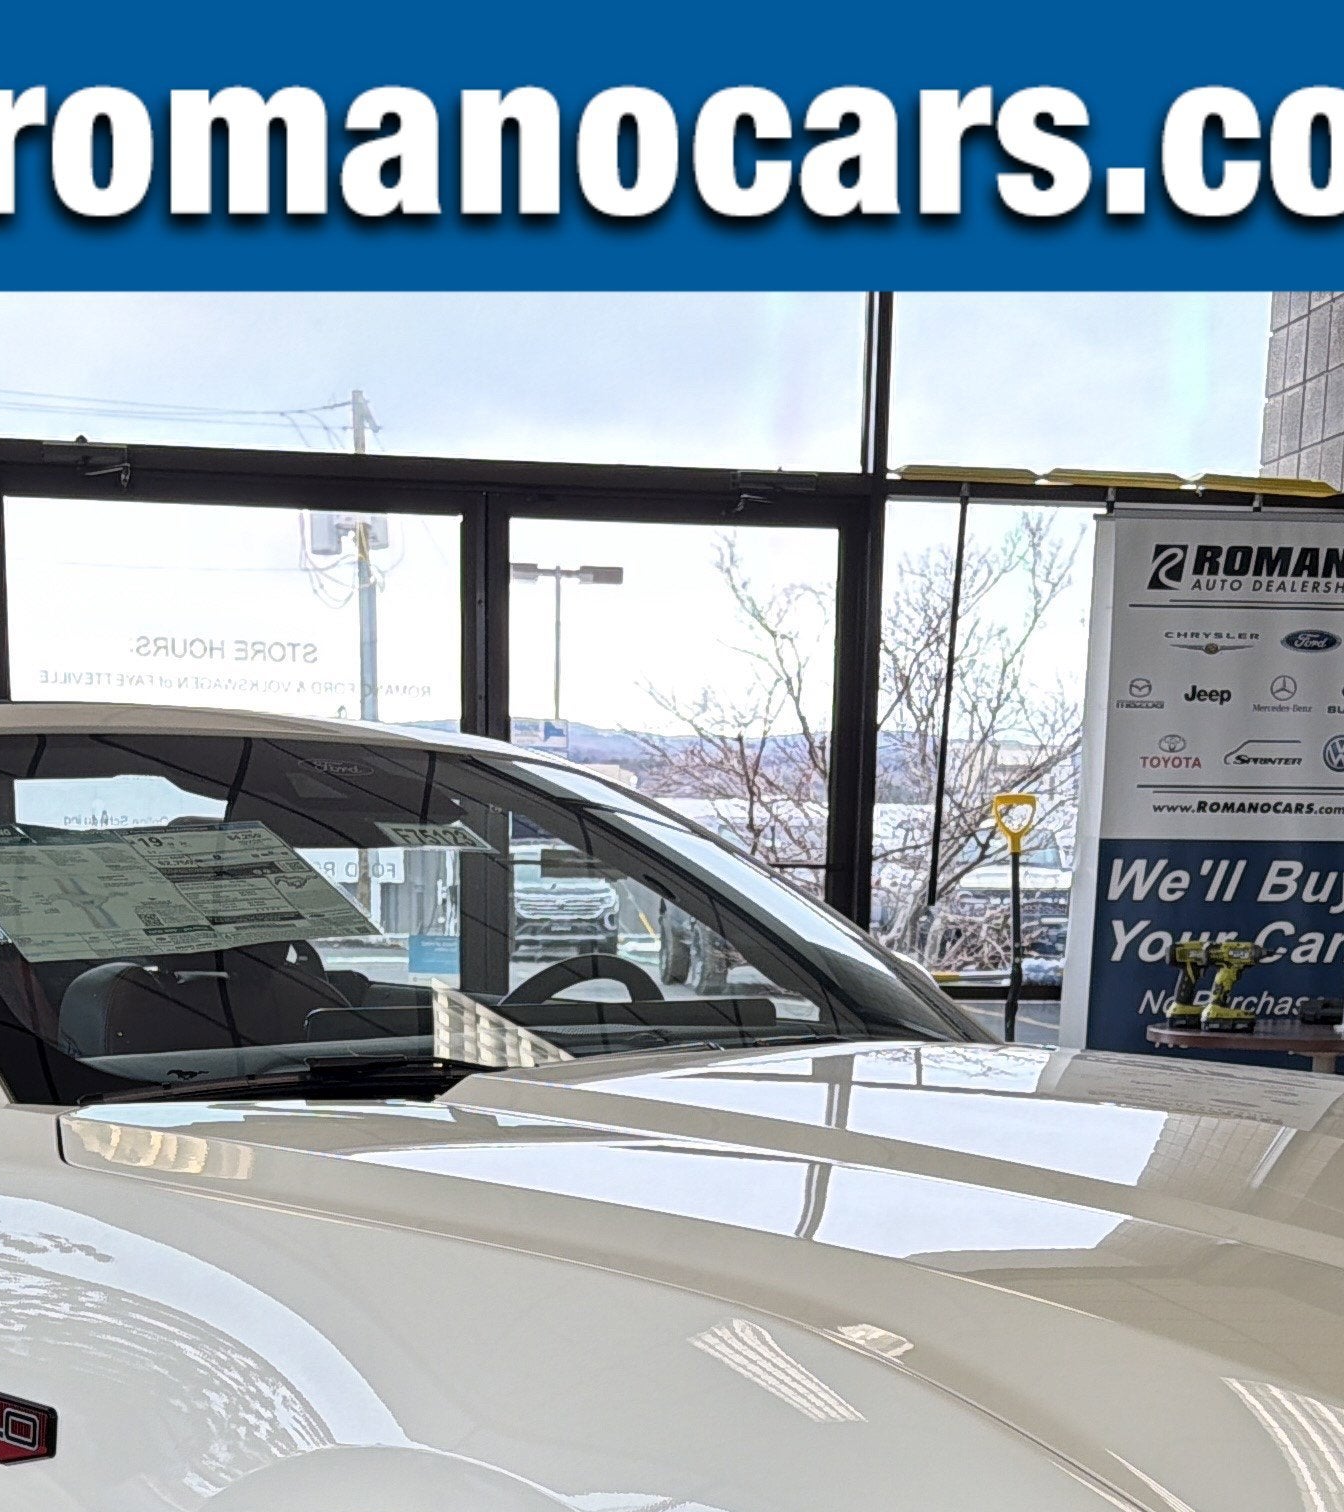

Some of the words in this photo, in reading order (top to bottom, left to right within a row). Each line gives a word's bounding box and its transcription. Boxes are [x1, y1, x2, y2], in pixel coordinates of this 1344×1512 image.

[1191, 578, 1243, 593] AUTO
[1163, 631, 1261, 640] CHRYSLER
[1293, 633, 1328, 650] Ford
[1184, 684, 1232, 706] Jeep
[1252, 703, 1313, 713] Mercedes-Benz
[1140, 756, 1202, 770] TOYOTA
[1233, 754, 1303, 766] SPRINTER
[137, 835, 164, 848] 19
[390, 827, 477, 848] F75123
[1107, 858, 1247, 903] We'll
[1192, 988, 1311, 1017] Prchas
